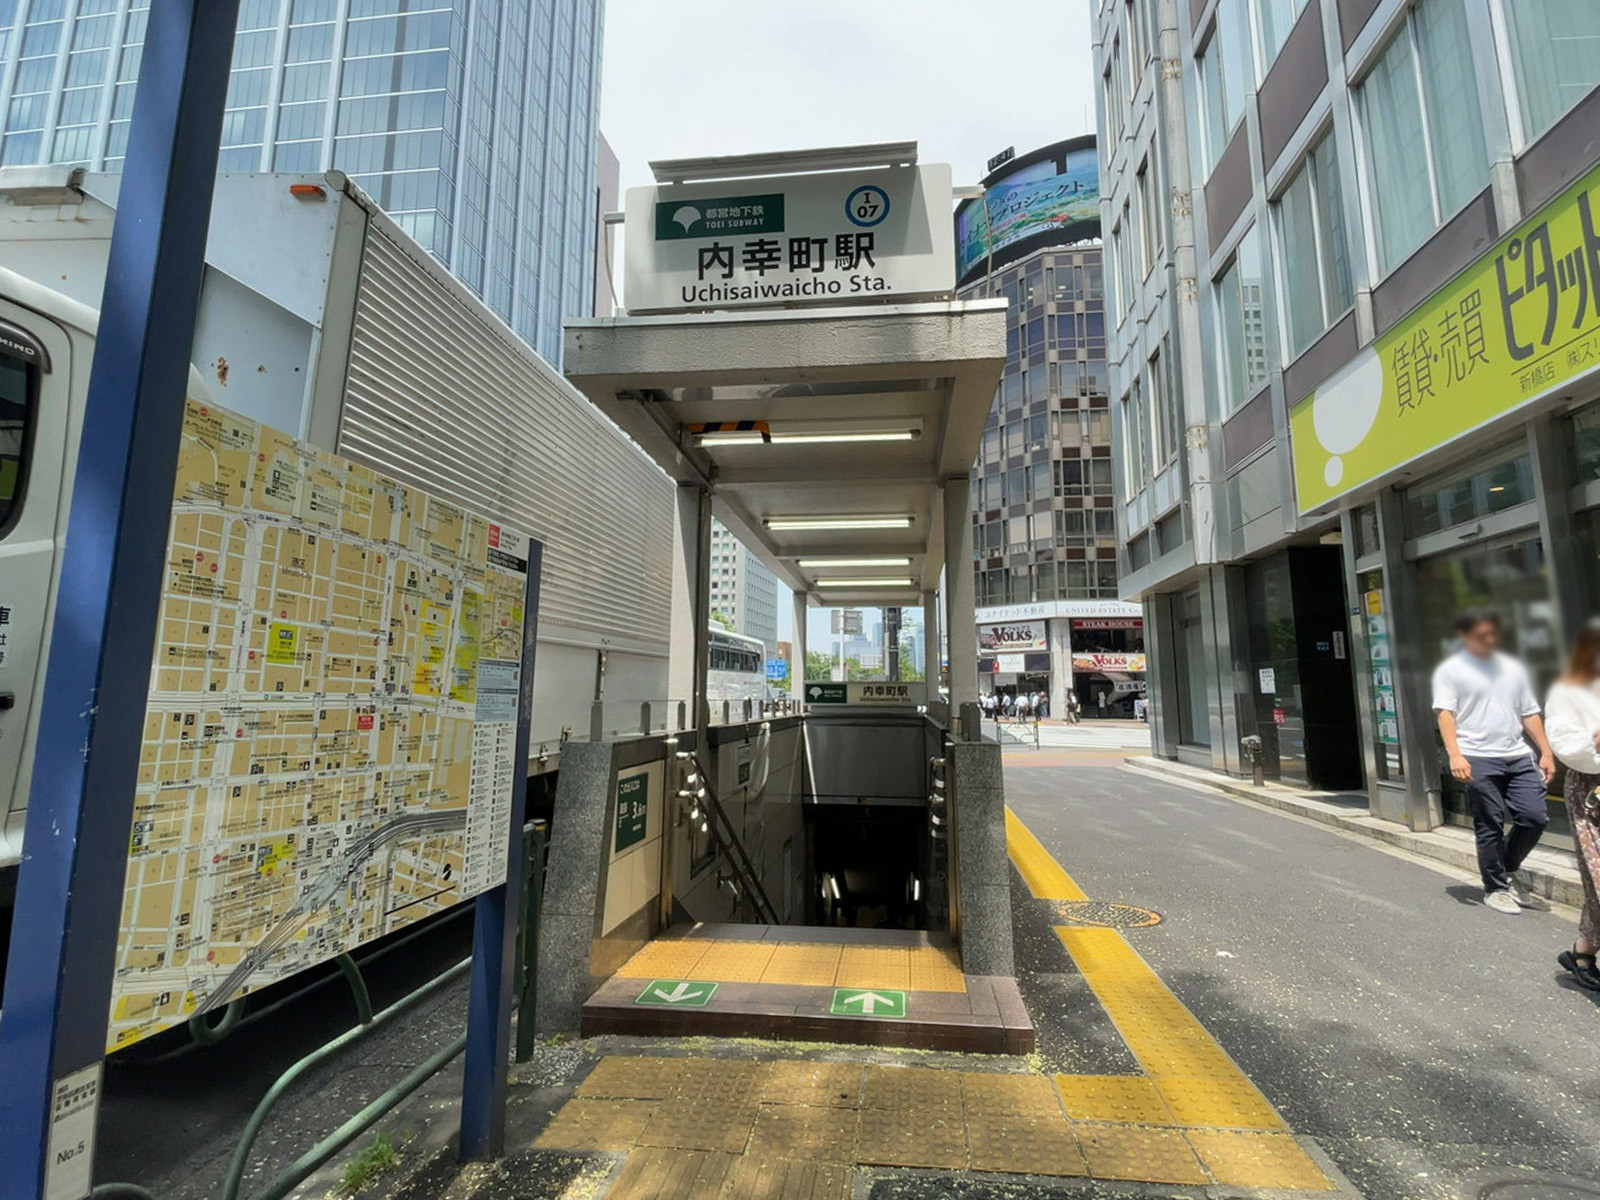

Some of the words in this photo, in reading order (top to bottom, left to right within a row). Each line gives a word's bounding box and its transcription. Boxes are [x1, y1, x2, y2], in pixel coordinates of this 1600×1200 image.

[863, 193, 871, 204] I
[705, 205, 765, 219] 都営地下鉄
[857, 204, 878, 219] 07
[705, 220, 725, 230] TOEI
[728, 217, 765, 229] SUBWAY
[697, 231, 876, 281] 内幸町駅
[681, 277, 842, 303] Uchisaiwaicho
[849, 273, 892, 293] Sta.
[1092, 654, 1127, 667] VOLKS
[863, 685, 908, 697] 内幸町駅
[57, 1140, 85, 1165] No.5
